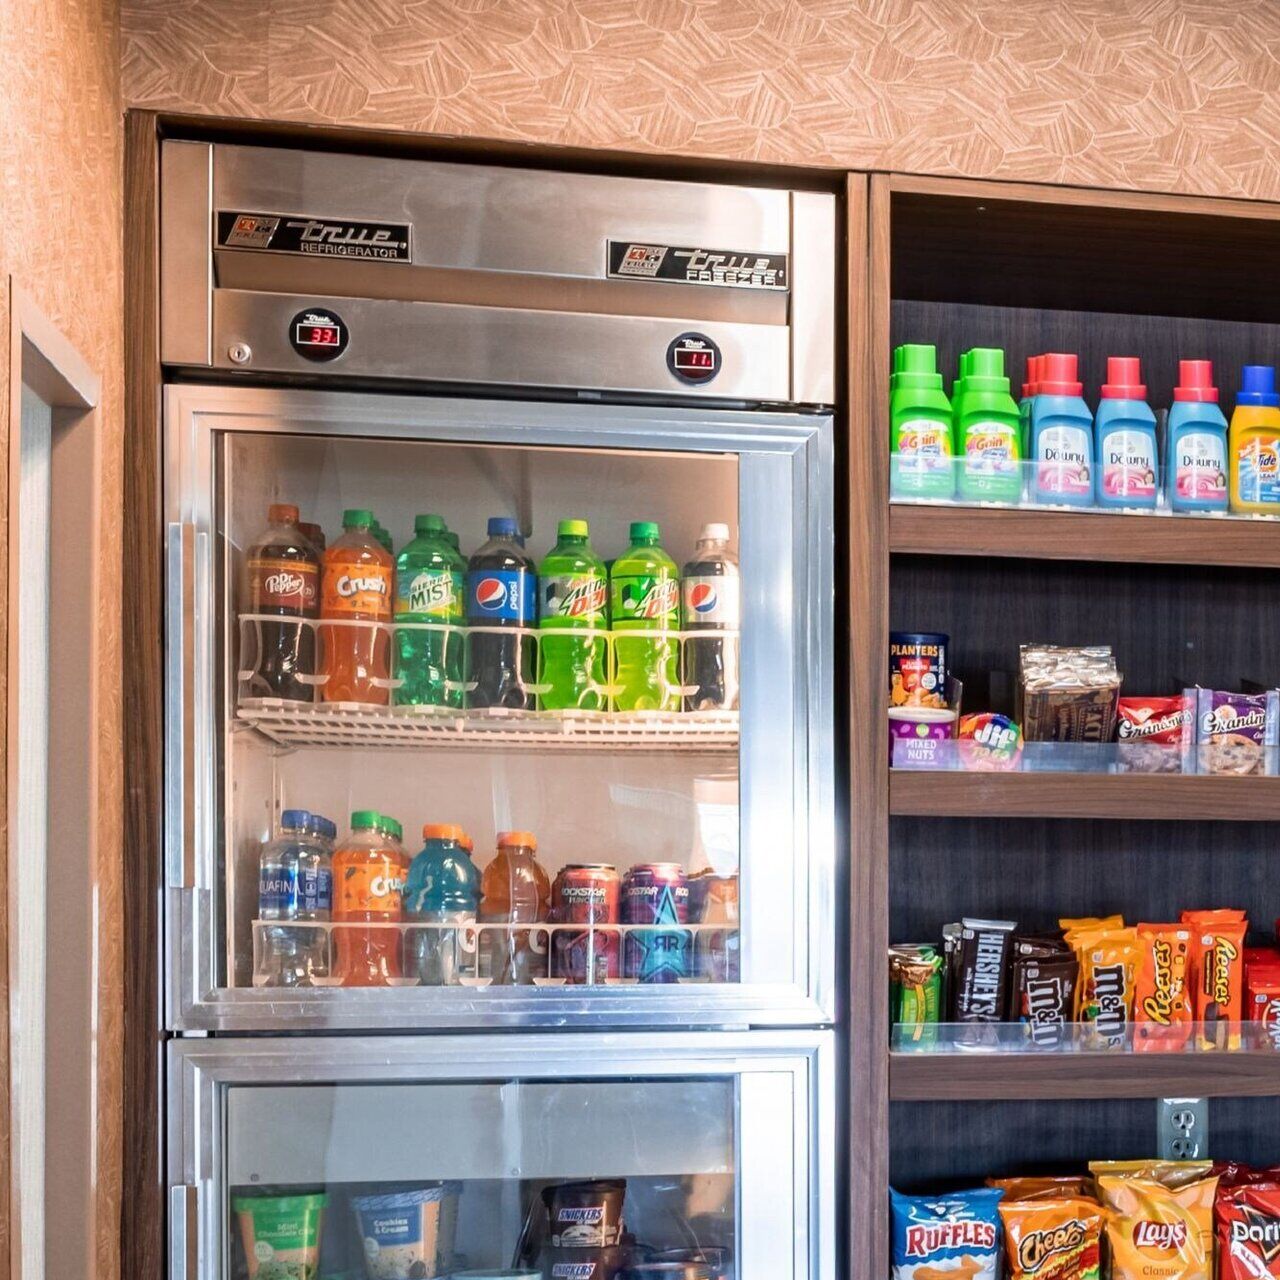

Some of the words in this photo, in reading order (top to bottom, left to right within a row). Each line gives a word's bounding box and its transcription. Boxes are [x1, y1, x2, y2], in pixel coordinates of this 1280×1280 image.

[300, 242, 398, 258] REFRIGERATOR
[1258, 453, 1277, 466] Tide
[269, 577, 302, 596] Pepper
[336, 575, 387, 597] Crush
[409, 582, 452, 611] MIST
[509, 581, 518, 610] pepsi
[891, 644, 939, 656] PLANTERS
[974, 722, 1017, 749] Jif
[906, 739, 937, 749] MIXED
[907, 750, 935, 760] NUTS
[970, 931, 1005, 1014] HERSHEY'S
[559, 1208, 603, 1220] SNICKERS
[373, 1218, 408, 1227] Cookies
[905, 1220, 996, 1257] RUFFLES
[553, 1263, 594, 1276] SNICKERS
[1142, 1265, 1180, 1277] Classic
